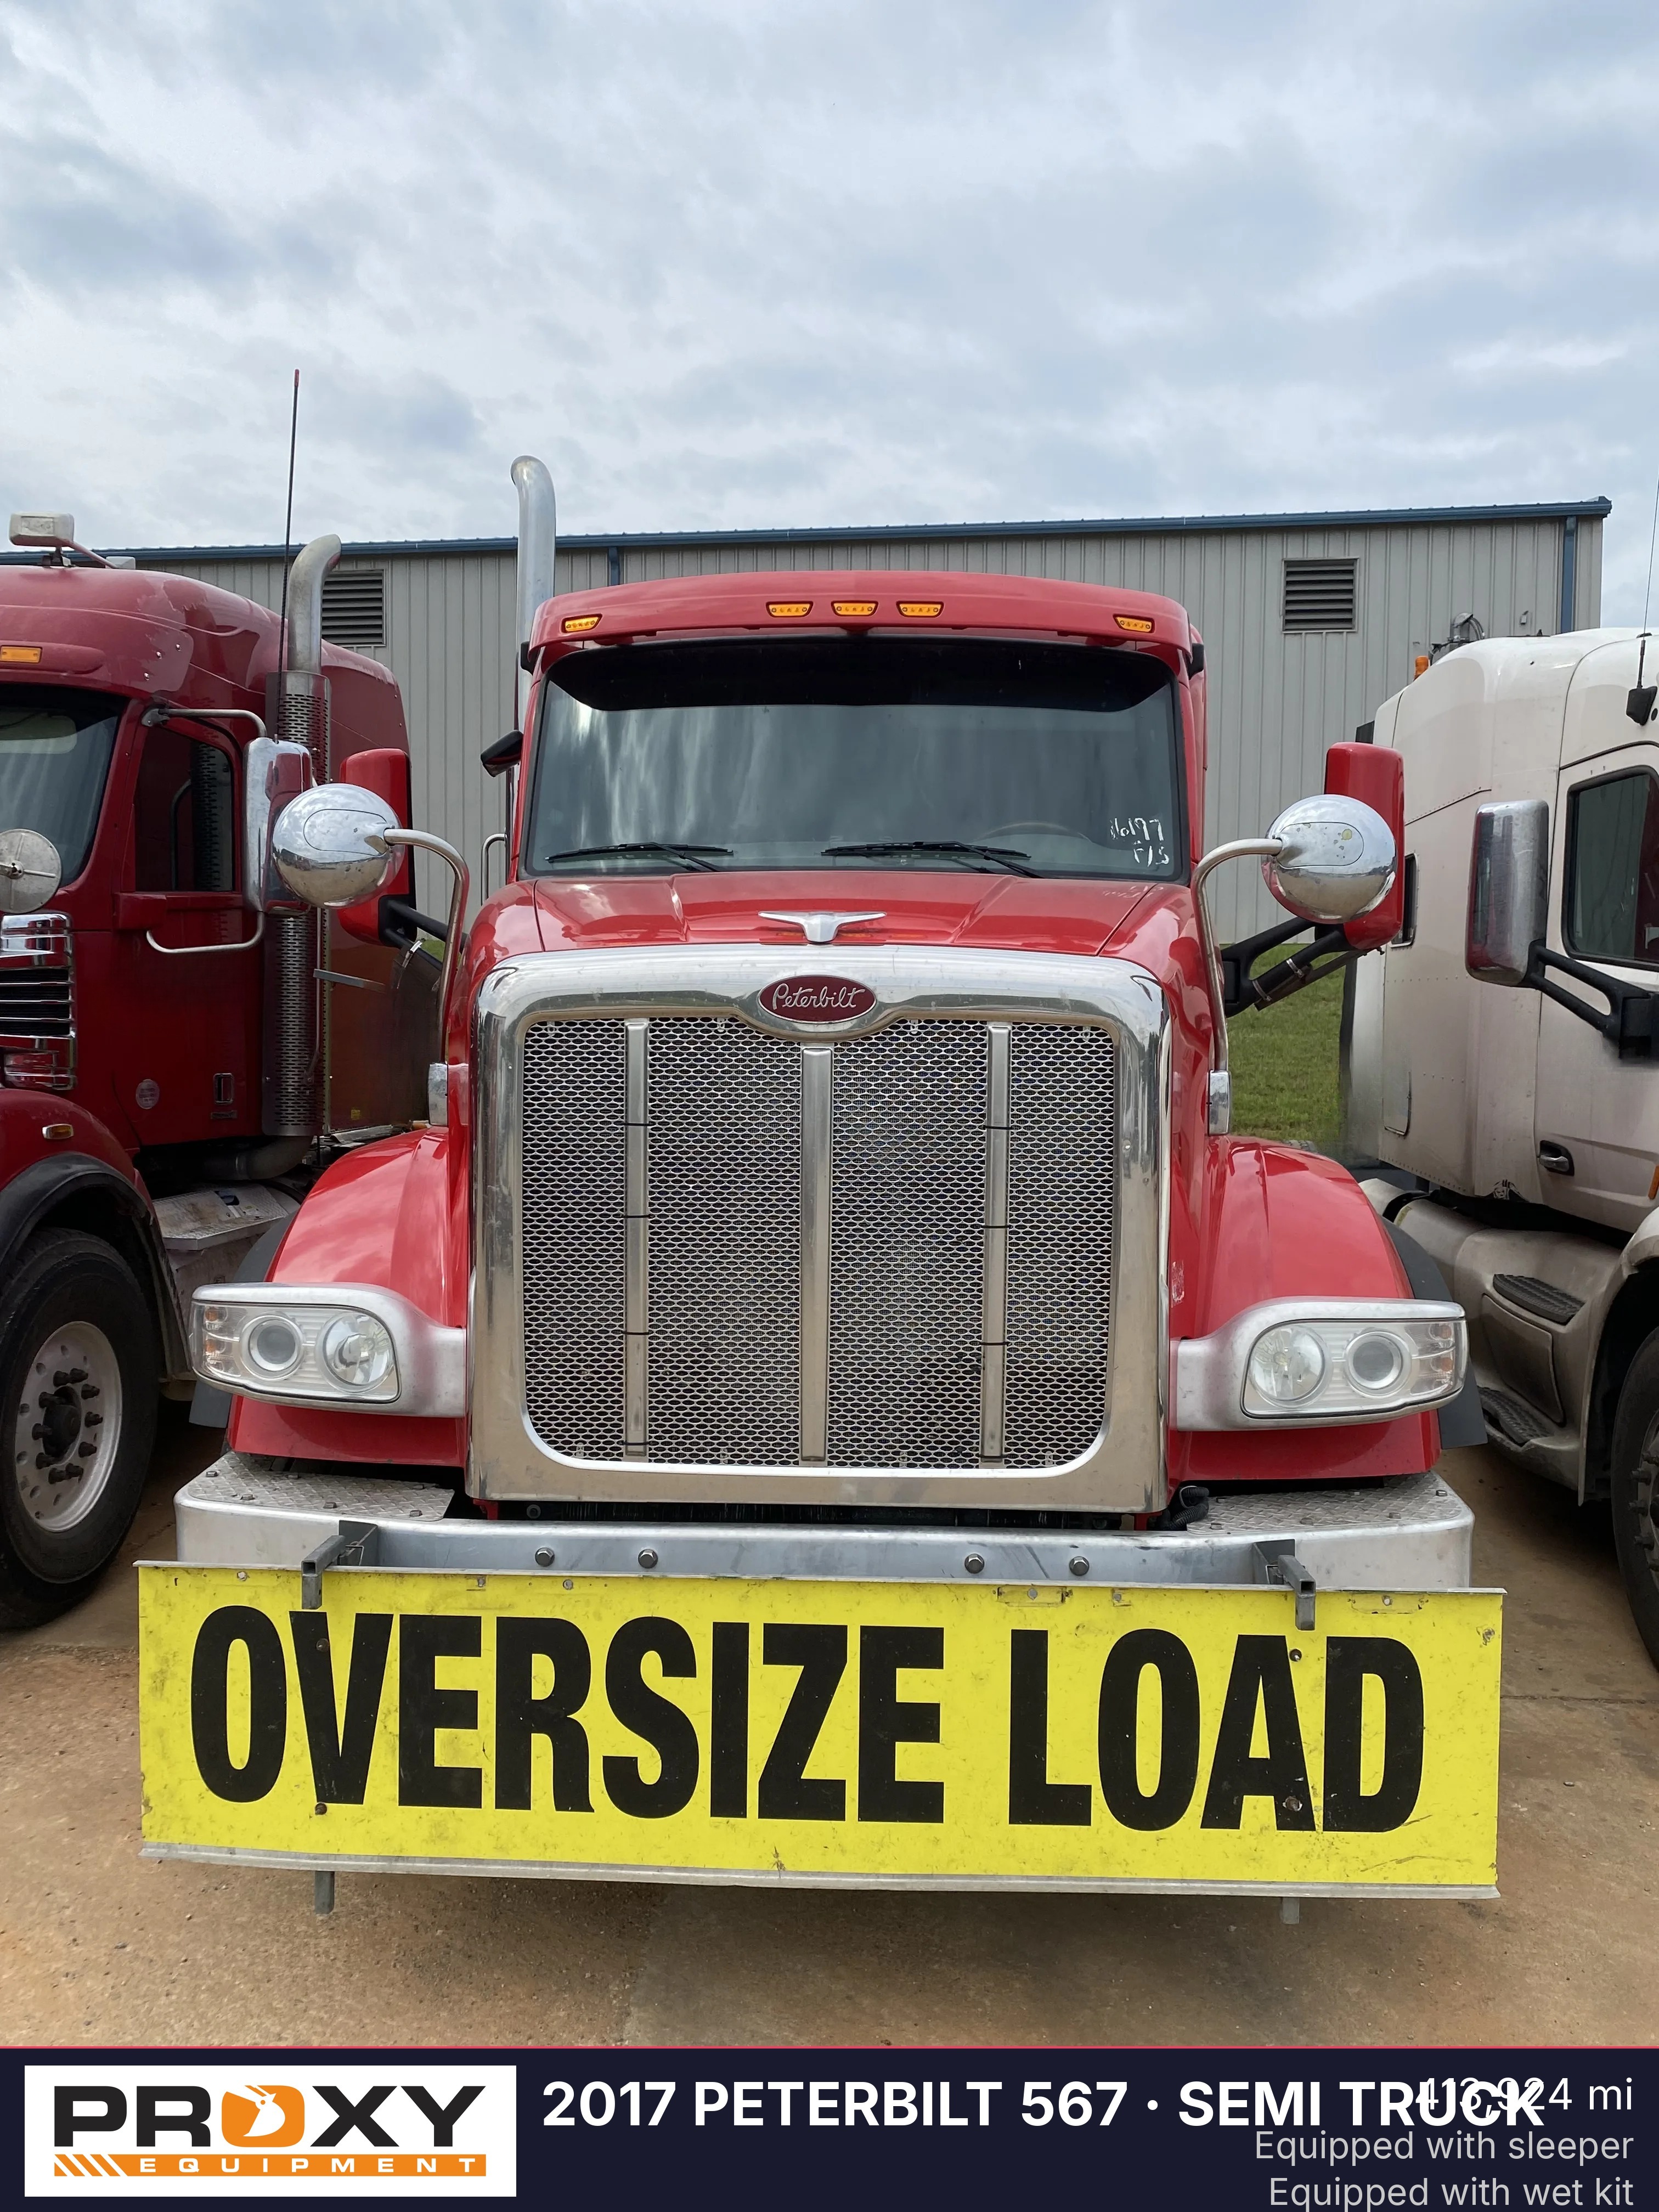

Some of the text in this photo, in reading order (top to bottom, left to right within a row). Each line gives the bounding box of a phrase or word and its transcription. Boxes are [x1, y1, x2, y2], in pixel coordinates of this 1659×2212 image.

[772, 983, 866, 1010] Peterbilt
[190, 1604, 1425, 1832] OVERSIZE LOAD
